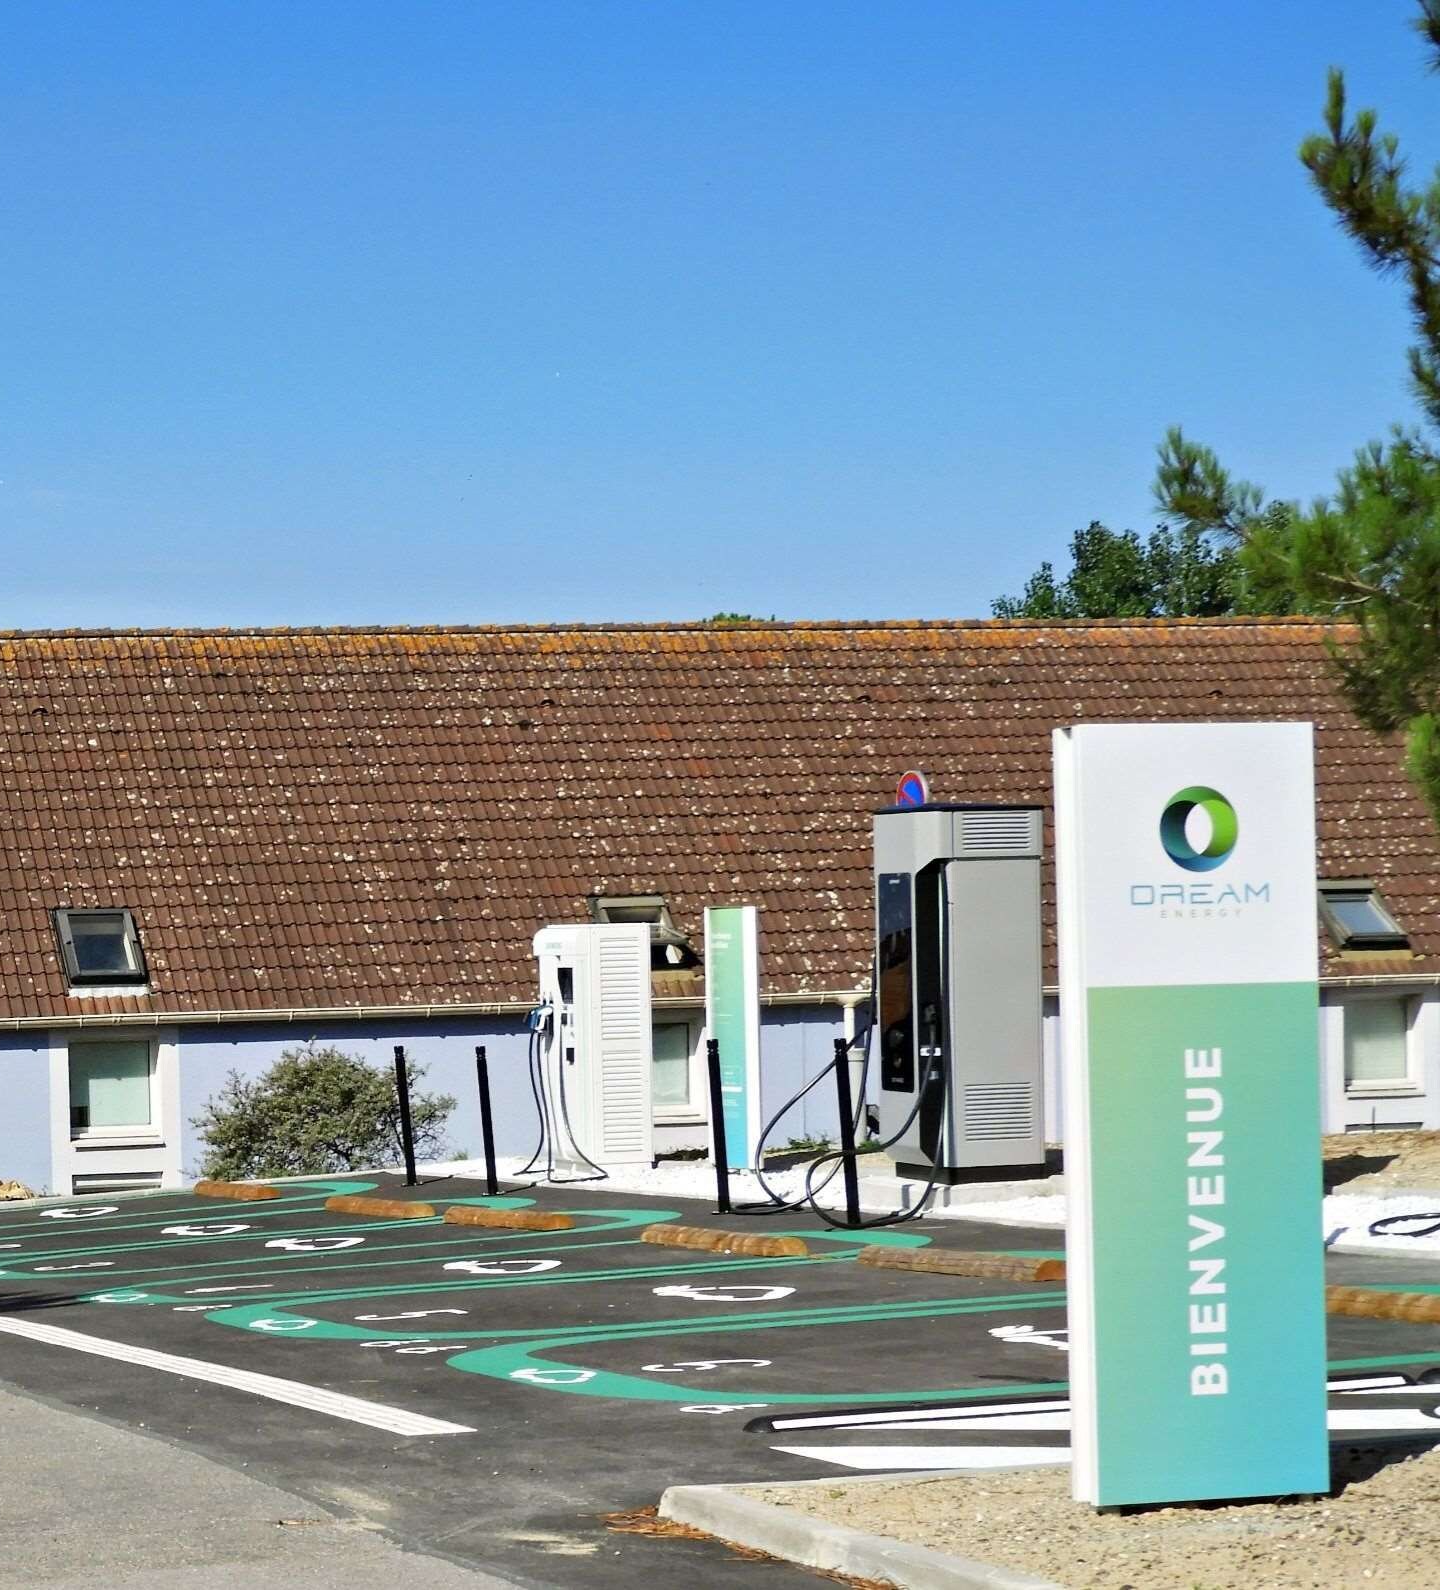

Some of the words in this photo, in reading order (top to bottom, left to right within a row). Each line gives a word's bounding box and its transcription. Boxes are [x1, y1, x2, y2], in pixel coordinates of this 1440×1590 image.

[1131, 882, 1270, 905] DREAM
[1160, 908, 1241, 919] ENERGY
[1185, 1047, 1229, 1396] BIENVENUE
